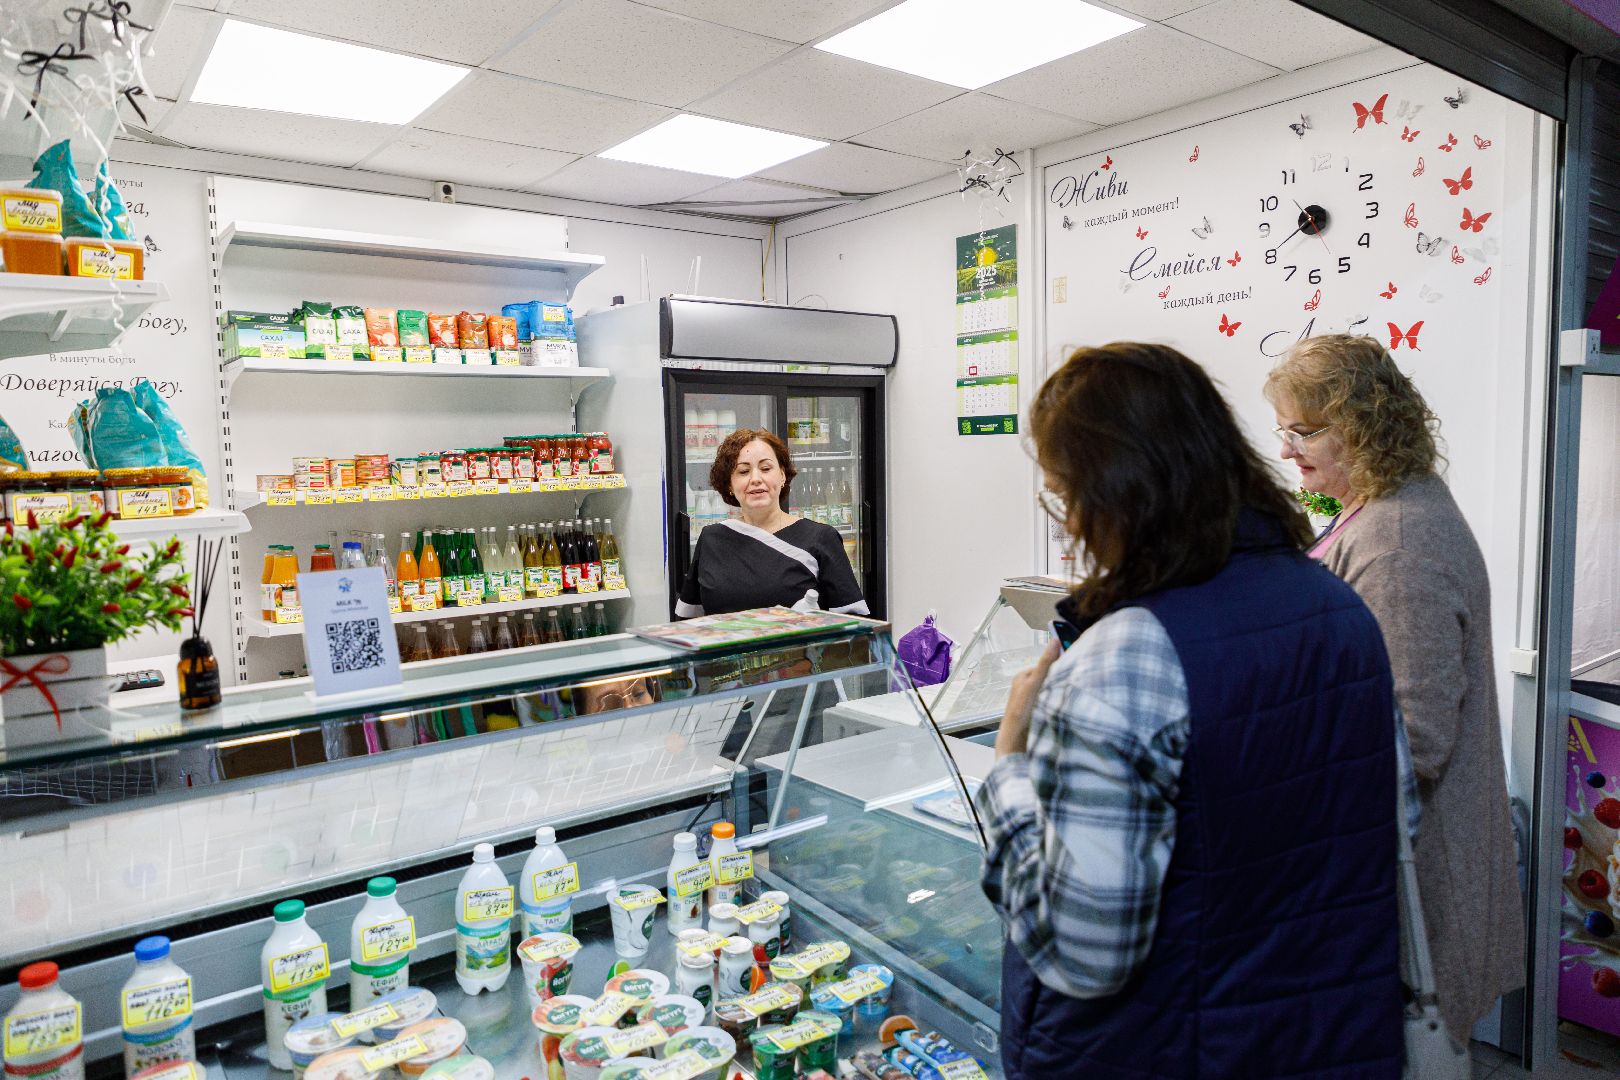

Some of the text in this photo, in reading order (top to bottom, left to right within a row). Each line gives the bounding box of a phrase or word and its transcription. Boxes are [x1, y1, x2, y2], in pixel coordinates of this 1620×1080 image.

[1281, 169, 1296, 185] 11
[1358, 173, 1373, 191] 2
[1051, 170, 1129, 209] Живи
[1084, 196, 1179, 229] каждый момент!
[1259, 195, 1279, 213] 10
[1365, 201, 1379, 219] 3
[21, 215, 45, 227] 700
[1258, 222, 1270, 238] 9
[1357, 232, 1370, 249] 4
[1120, 246, 1222, 281] Смейся
[1264, 248, 1277, 265] 8
[1337, 256, 1351, 273] 5
[976, 264, 997, 279] 2025
[1283, 265, 1297, 282] 7
[1308, 268, 1322, 285] 6
[1163, 286, 1252, 311] каждый день!
[60, 354, 106, 366] минуты
[545, 917, 560, 925] ТАН
[379, 938, 401, 953] 127
[369, 976, 399, 988] КЕФИР
[281, 999, 313, 1013] КЕФИР
